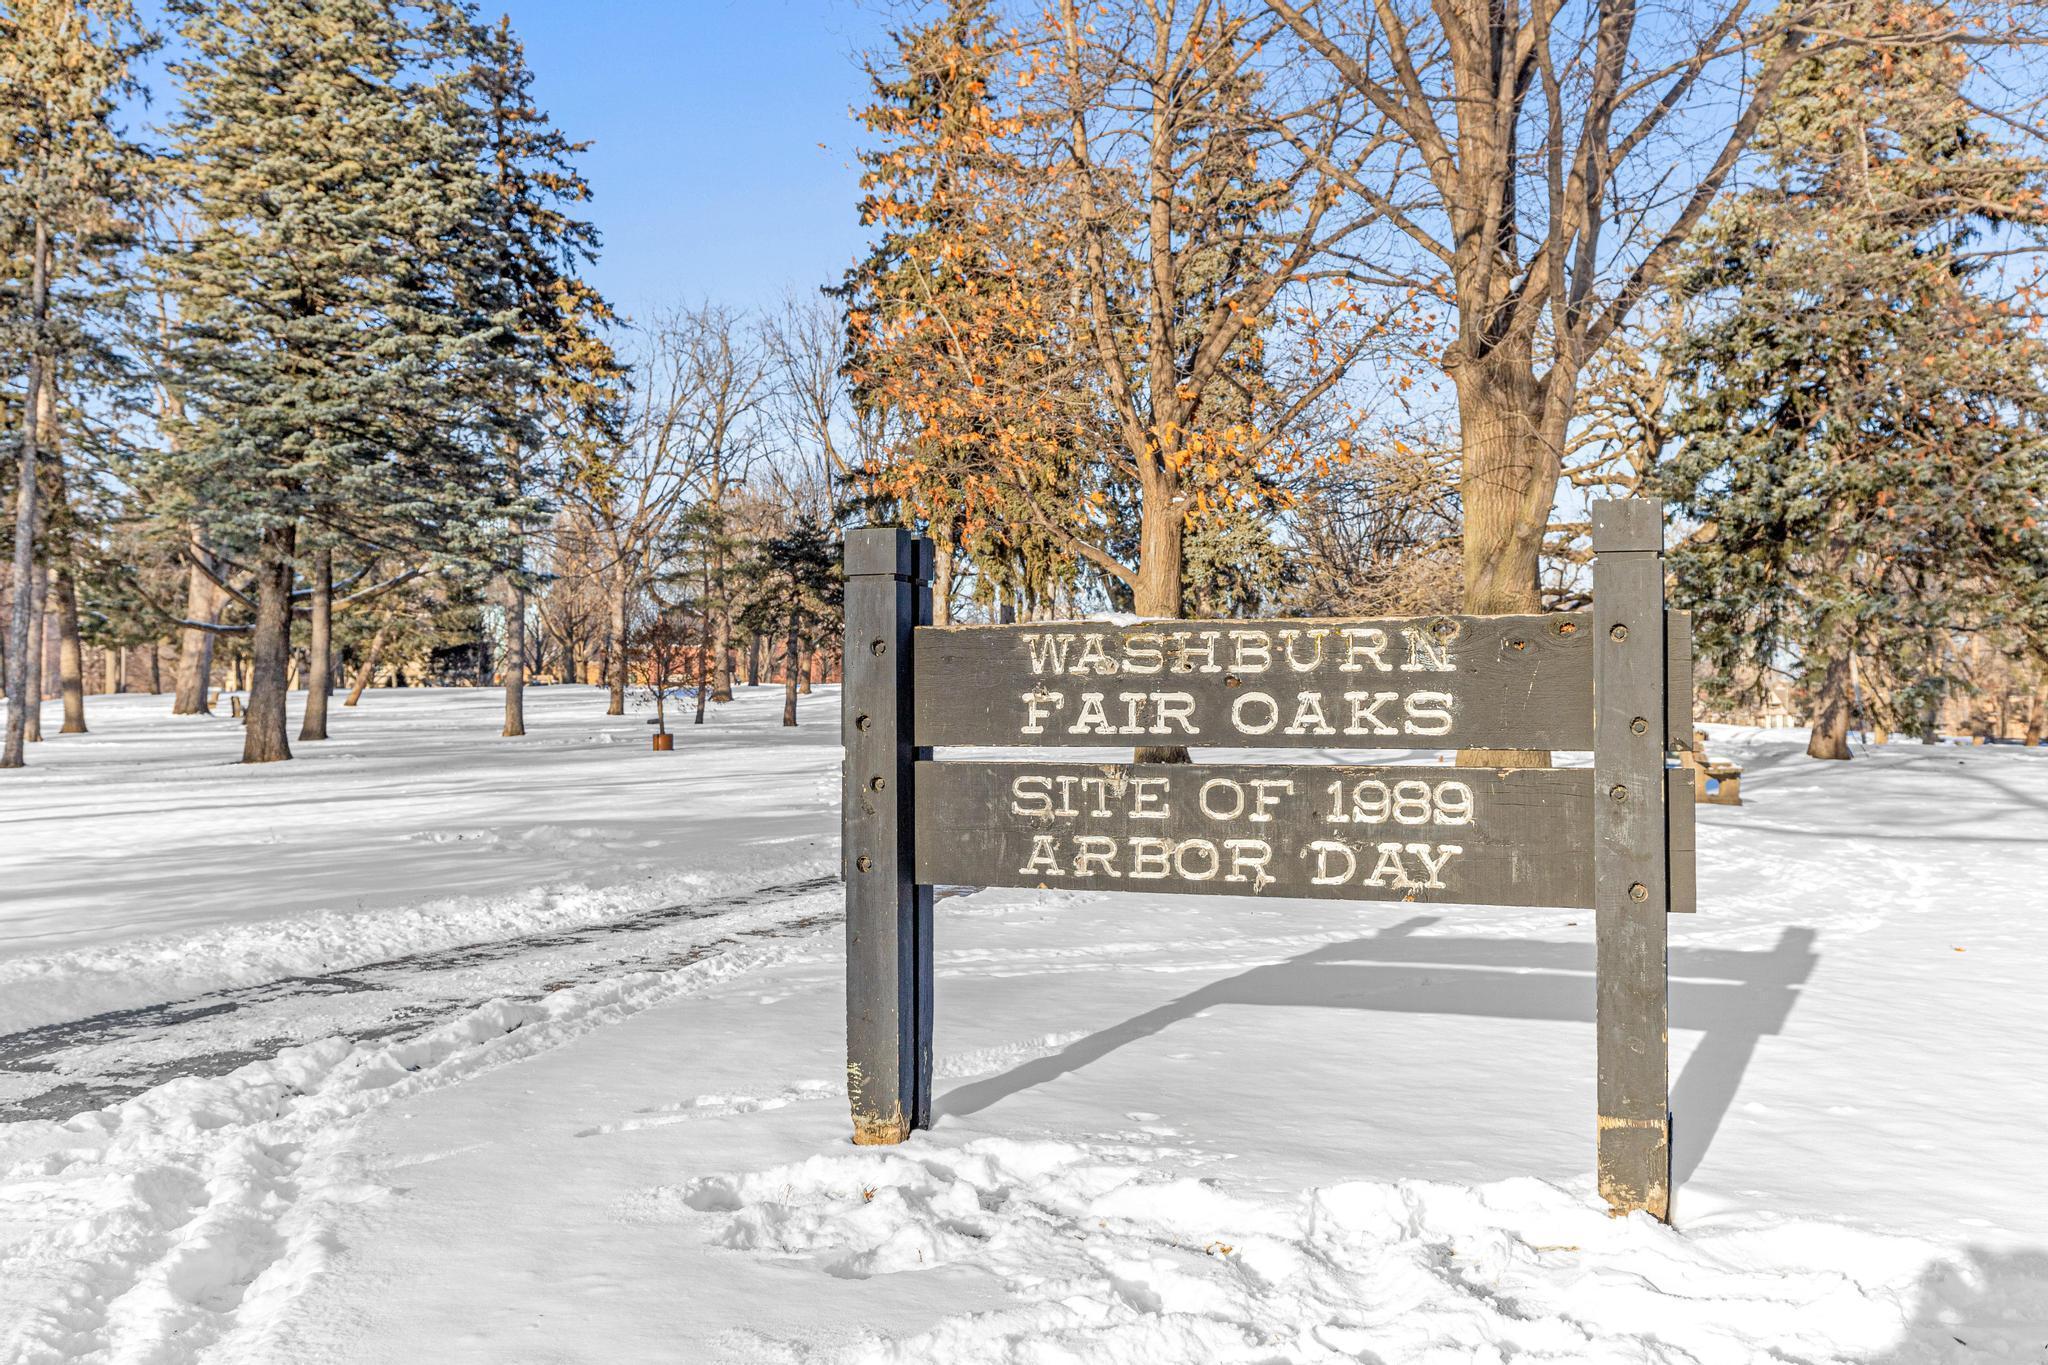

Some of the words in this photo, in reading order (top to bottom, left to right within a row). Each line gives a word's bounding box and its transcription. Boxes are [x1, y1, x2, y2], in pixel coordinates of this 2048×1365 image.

[1022, 628, 1457, 675] WASHBURN
[1020, 691, 1199, 735] FAIR
[1231, 690, 1454, 737] OAKS
[1011, 775, 1171, 819] SITE
[1199, 777, 1294, 822] OF
[1326, 779, 1475, 826] 1989
[1019, 835, 1276, 884] ARBOR
[1310, 840, 1463, 889] DAY
